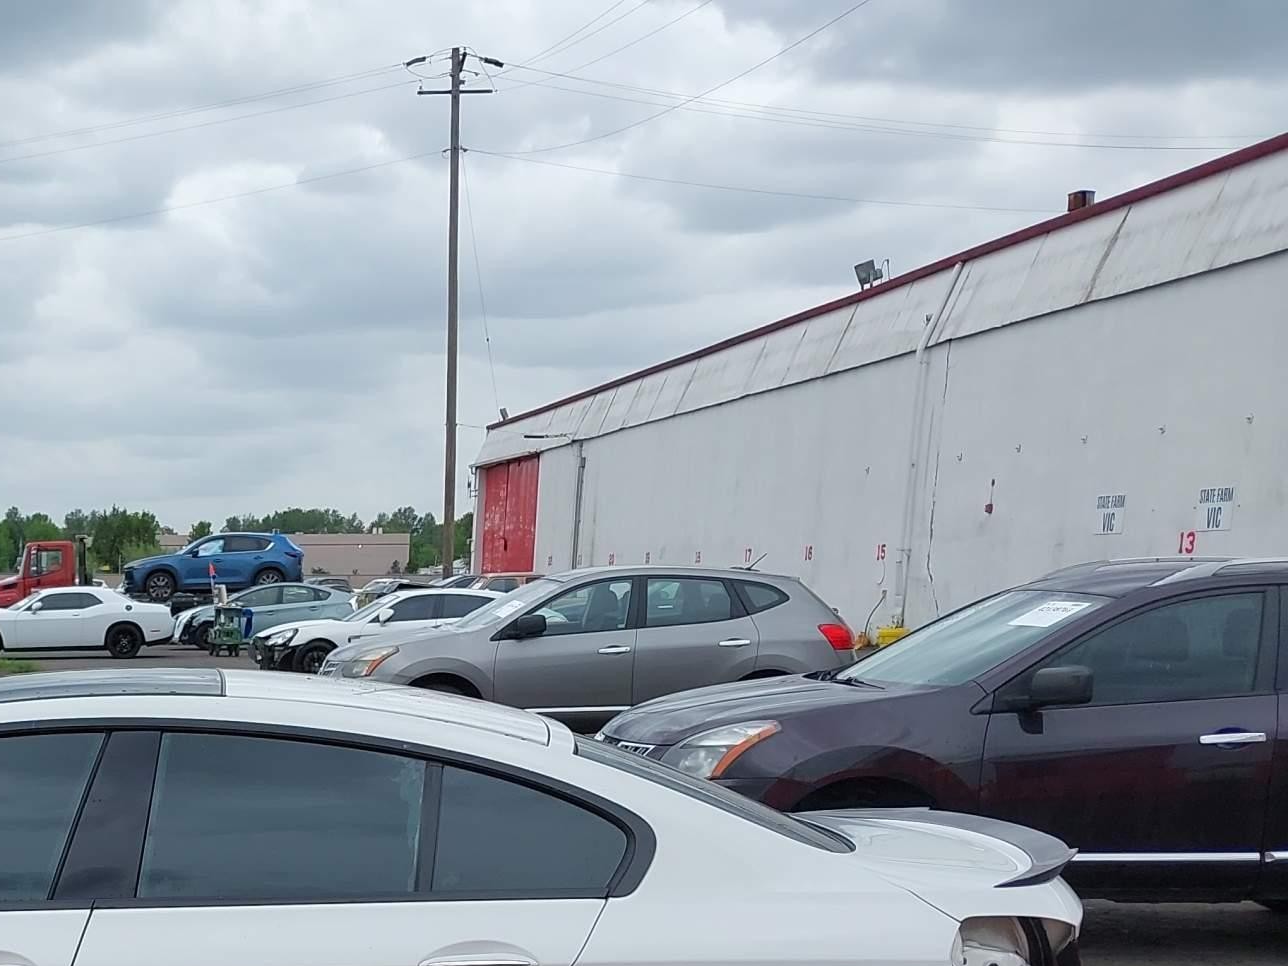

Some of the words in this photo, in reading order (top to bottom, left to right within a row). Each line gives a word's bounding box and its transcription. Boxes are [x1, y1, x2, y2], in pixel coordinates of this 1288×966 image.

[1097, 495, 1110, 509] STATE
[1111, 494, 1126, 509] FARM
[1200, 488, 1216, 504] STATE
[1216, 487, 1234, 503] FARM
[1102, 512, 1115, 533] VIC
[1206, 507, 1222, 529] VIC
[1178, 531, 1196, 554] 13
[876, 544, 886, 561] 15
